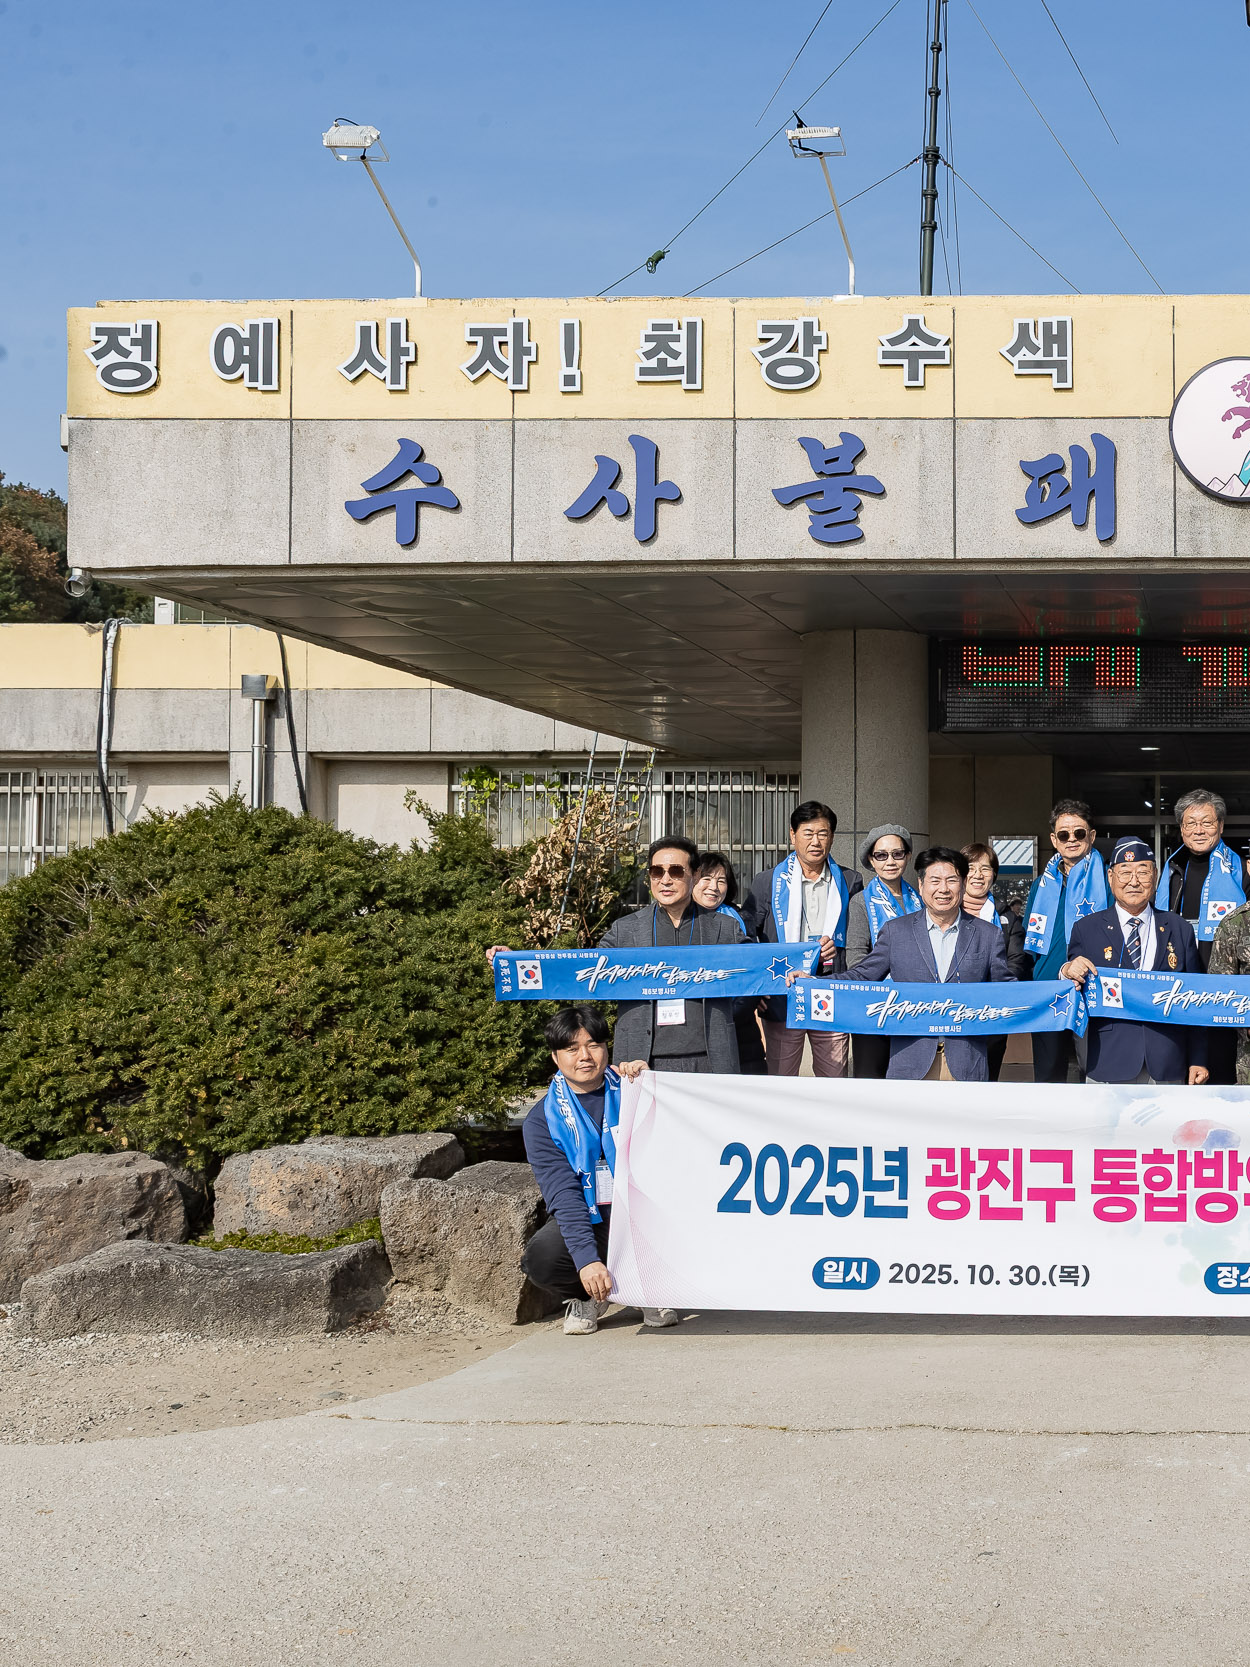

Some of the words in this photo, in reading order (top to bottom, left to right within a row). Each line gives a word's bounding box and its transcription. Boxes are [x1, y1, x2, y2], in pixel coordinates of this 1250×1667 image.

[716, 1141, 909, 1220] 2025년
[925, 1146, 1076, 1224] 광진구
[821, 1259, 869, 1286] 일시
[887, 1263, 959, 1286] 2025.
[967, 1264, 1001, 1286] 10.
[1008, 1264, 1091, 1288] 30.(목)
